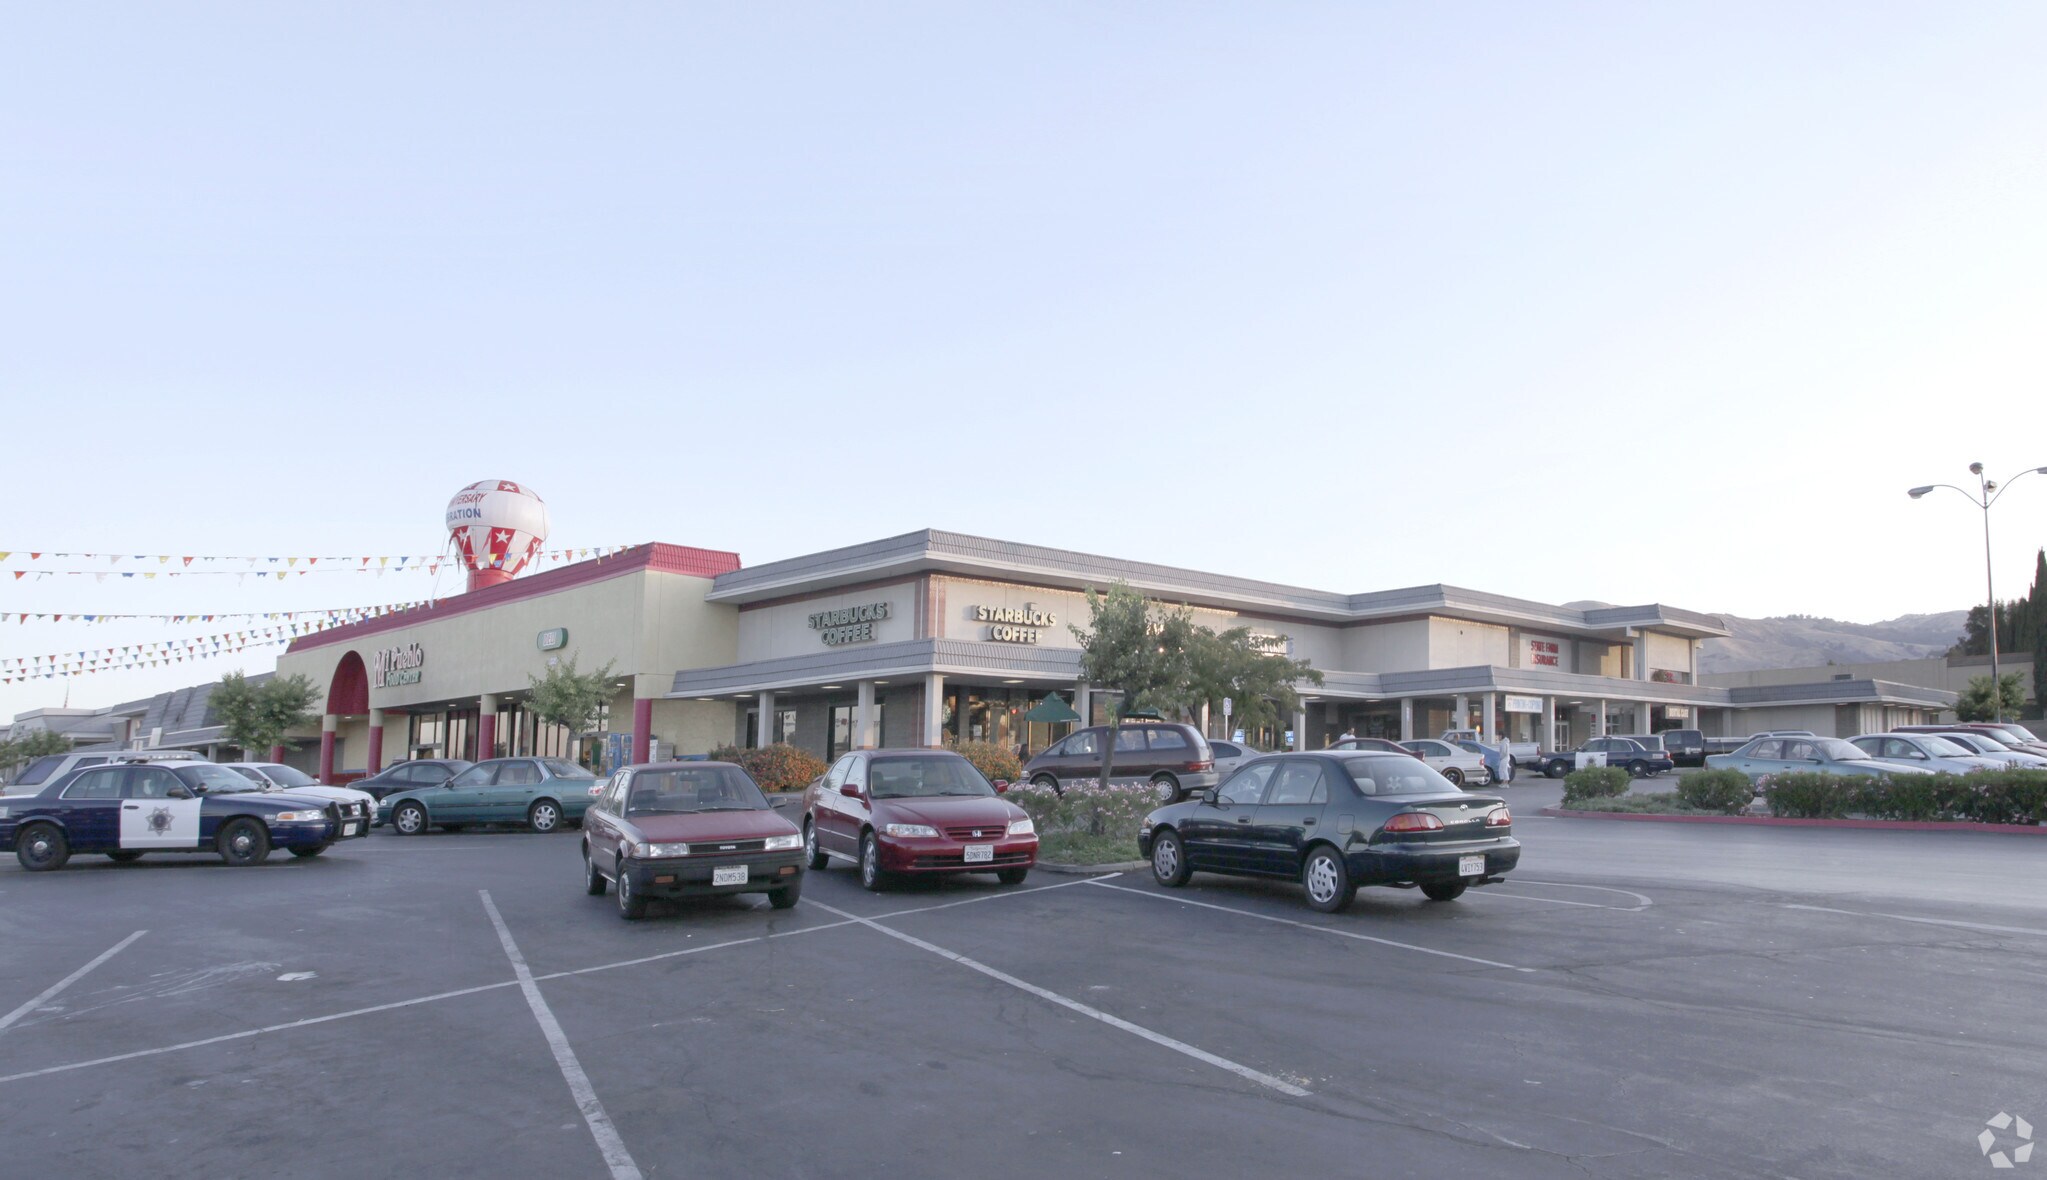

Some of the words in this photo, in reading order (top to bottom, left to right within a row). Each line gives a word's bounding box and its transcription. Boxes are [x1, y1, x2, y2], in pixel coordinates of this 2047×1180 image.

[808, 602, 887, 629] STARBUCKS
[977, 604, 1057, 627] STARBUCKS
[821, 623, 872, 646] COFFEE
[1531, 640, 1546, 652] STATE
[390, 642, 423, 671] Pueblo
[715, 871, 746, 883] 2NDM538
